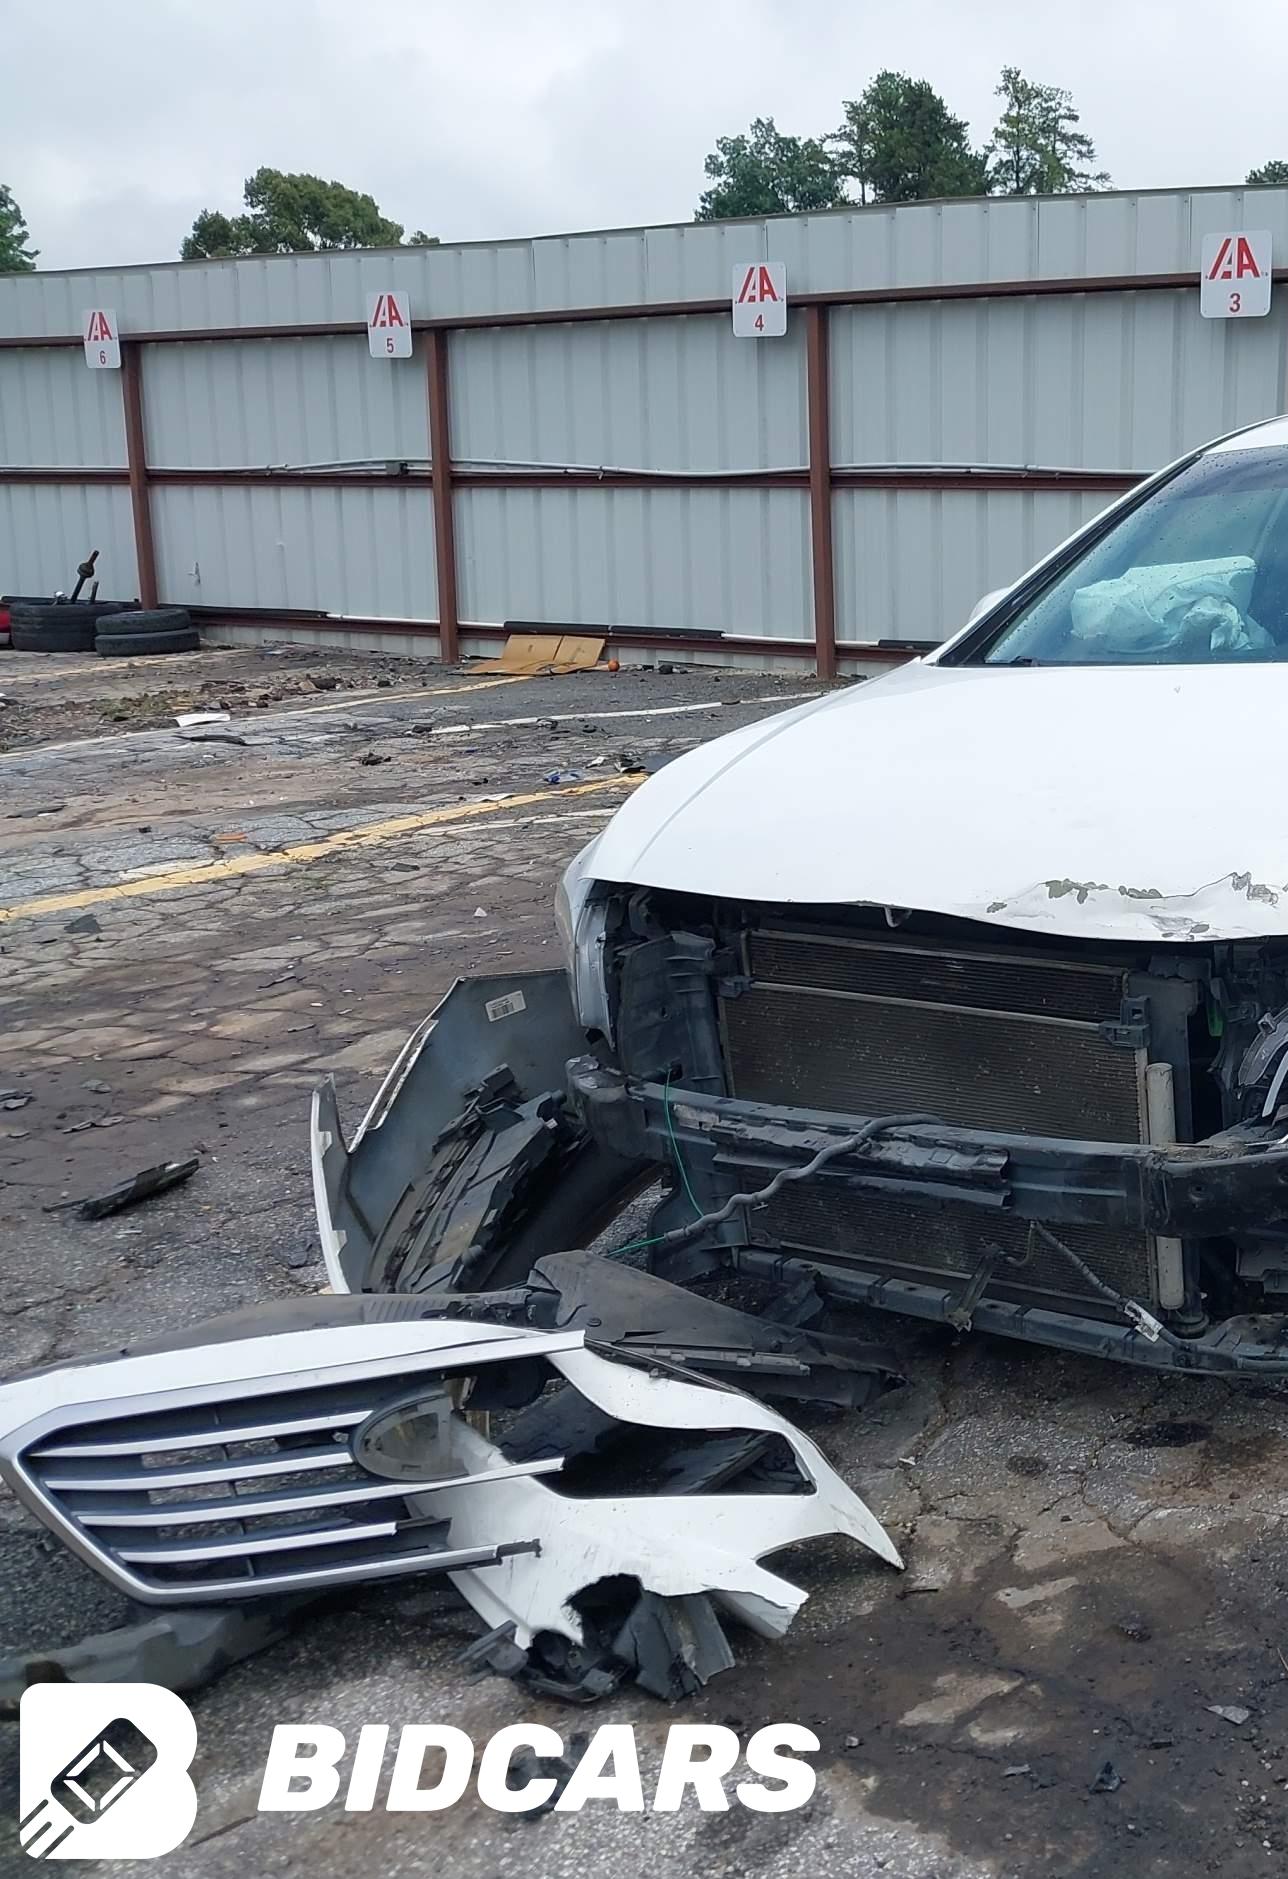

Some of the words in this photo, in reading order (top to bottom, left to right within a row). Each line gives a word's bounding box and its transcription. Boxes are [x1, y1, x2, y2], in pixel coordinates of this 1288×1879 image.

[1229, 292, 1241, 313] 3
[754, 313, 765, 332] 4
[386, 337, 394, 354] 5
[100, 350, 106, 365] 6
